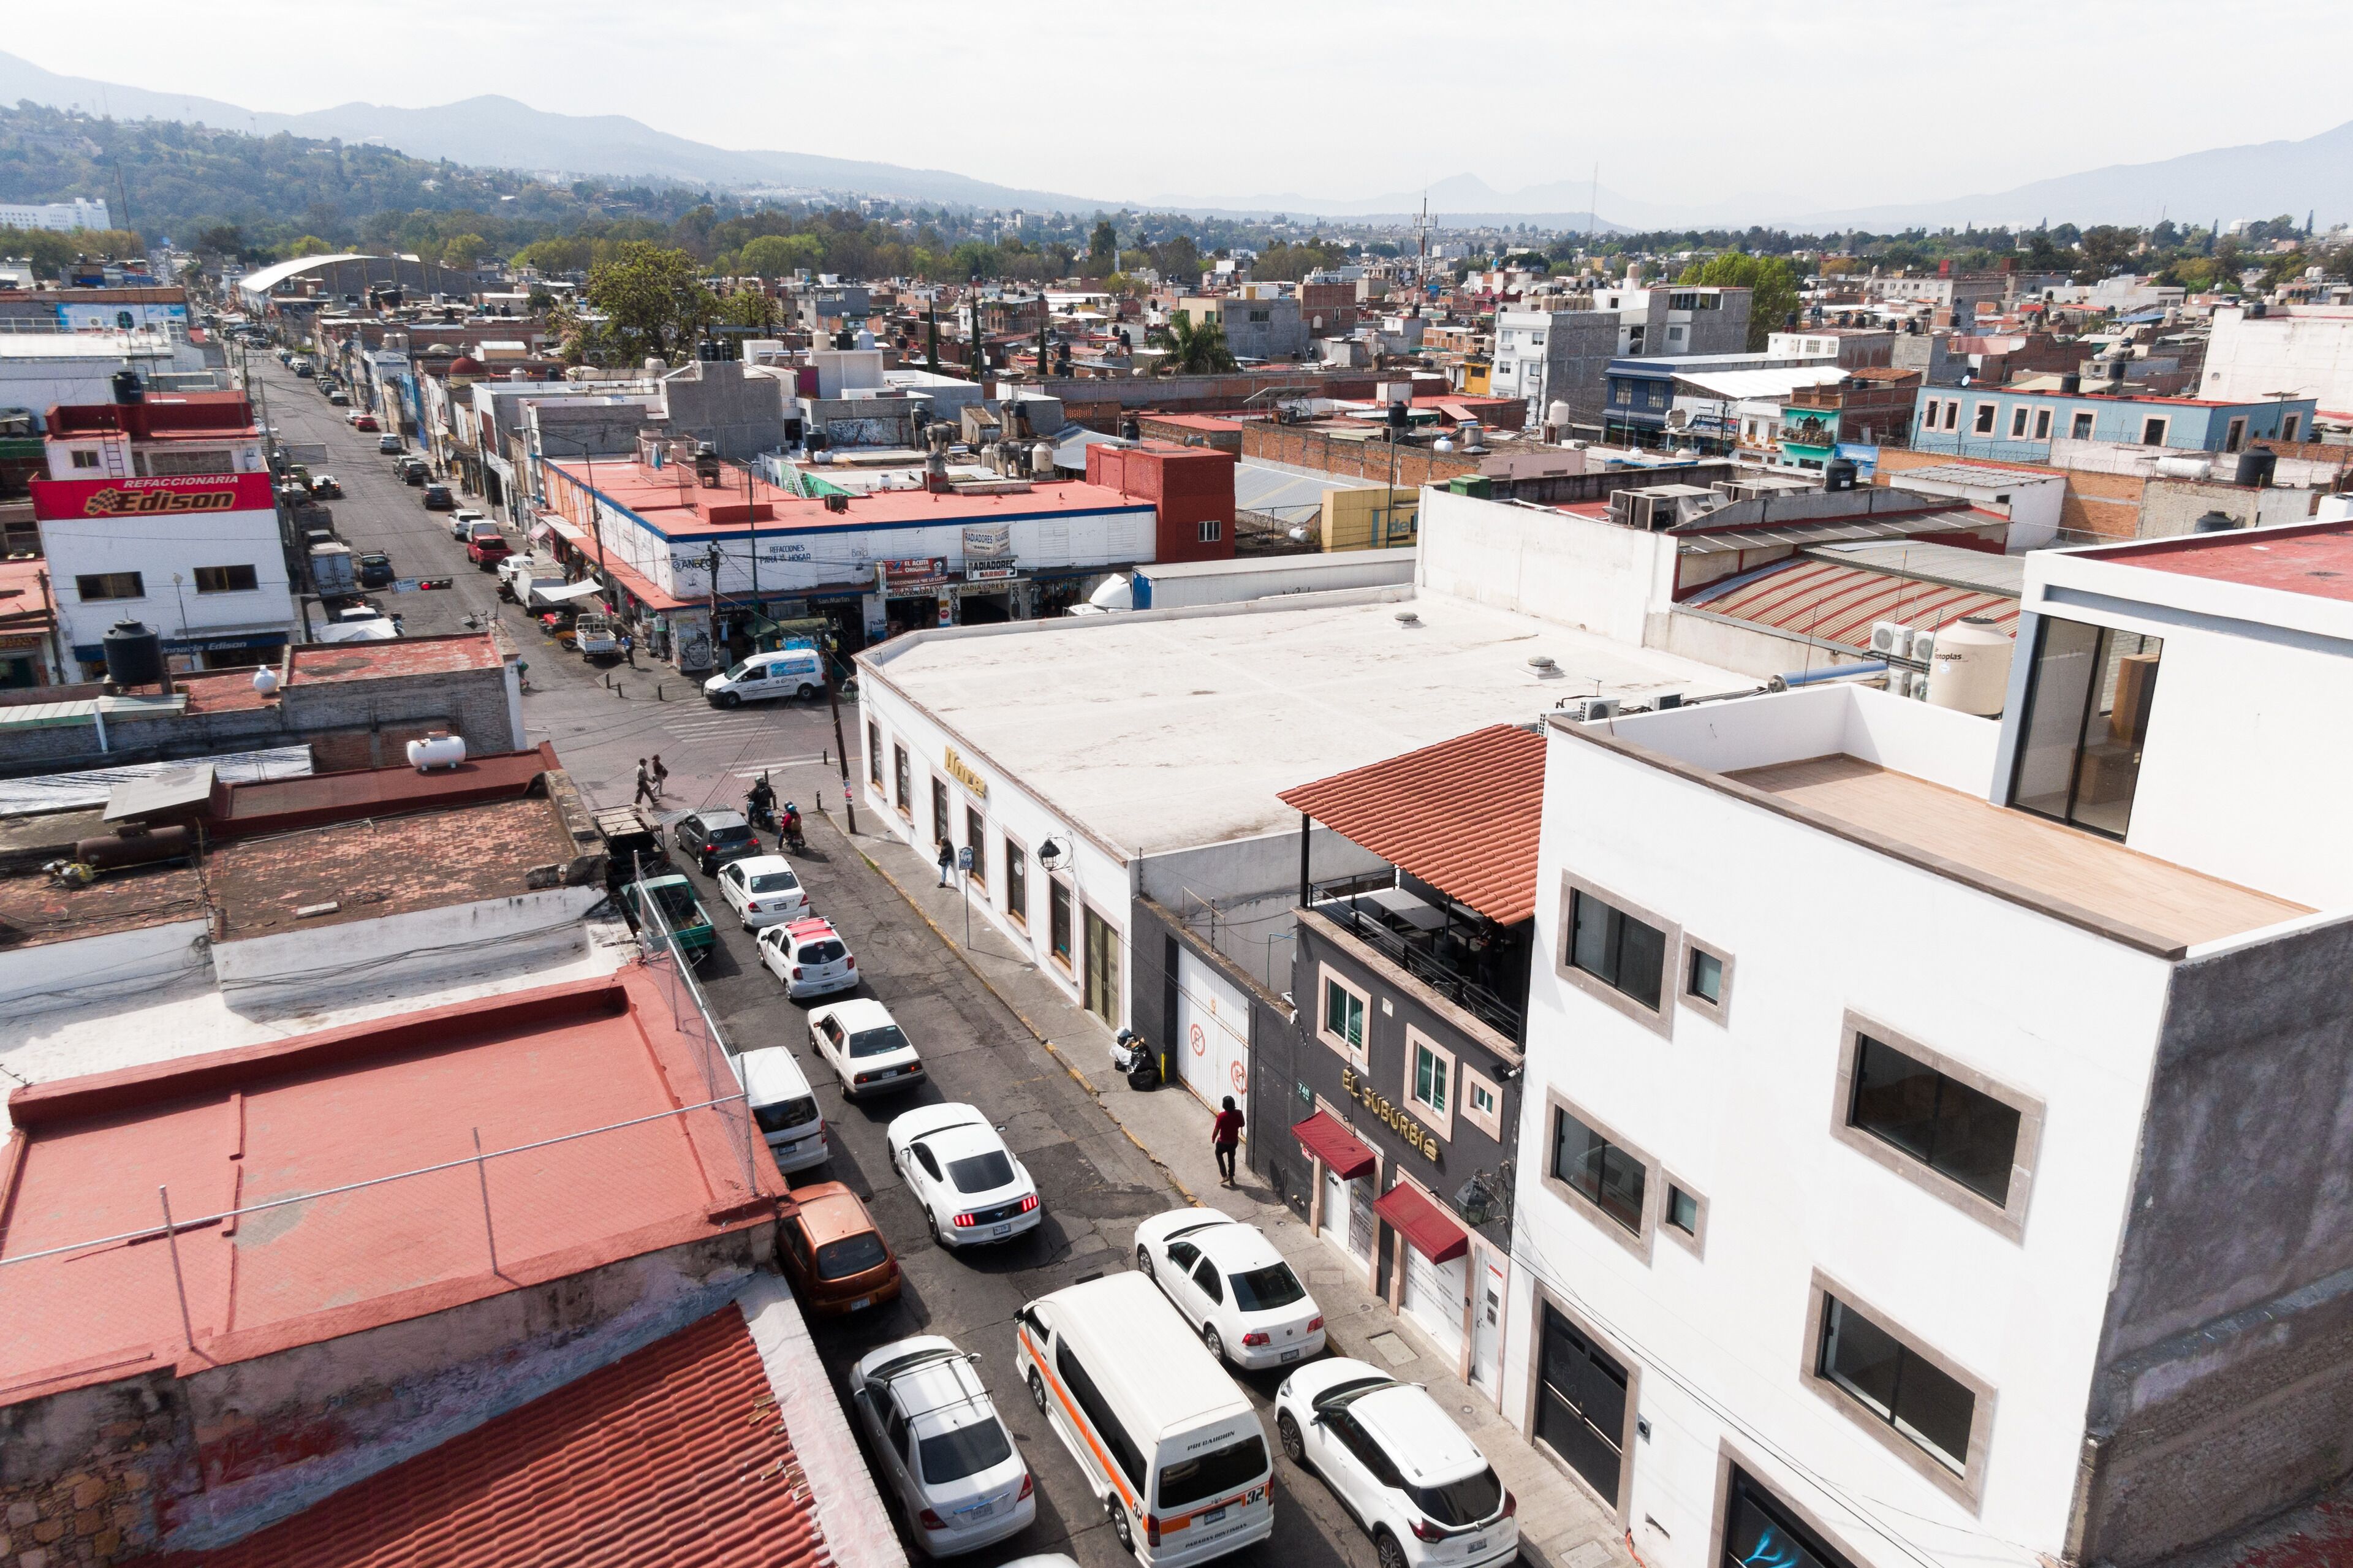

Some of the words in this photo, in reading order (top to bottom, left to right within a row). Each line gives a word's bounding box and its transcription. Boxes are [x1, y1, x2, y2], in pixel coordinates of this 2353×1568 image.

[123, 475, 239, 488] REFACCIONARIA
[112, 490, 235, 513] Edison
[965, 532, 993, 544] RADIADORES
[770, 545, 805, 553] REFACCIONES
[789, 553, 811, 562] HOGAR
[968, 559, 1016, 579] RADIADORES
[888, 589, 934, 598] REFACCIONARIA
[208, 642, 247, 650] Edison
[1343, 1069, 1360, 1098] EL
[1246, 1485, 1265, 1506] 32
[1133, 1502, 1143, 1524] 32
